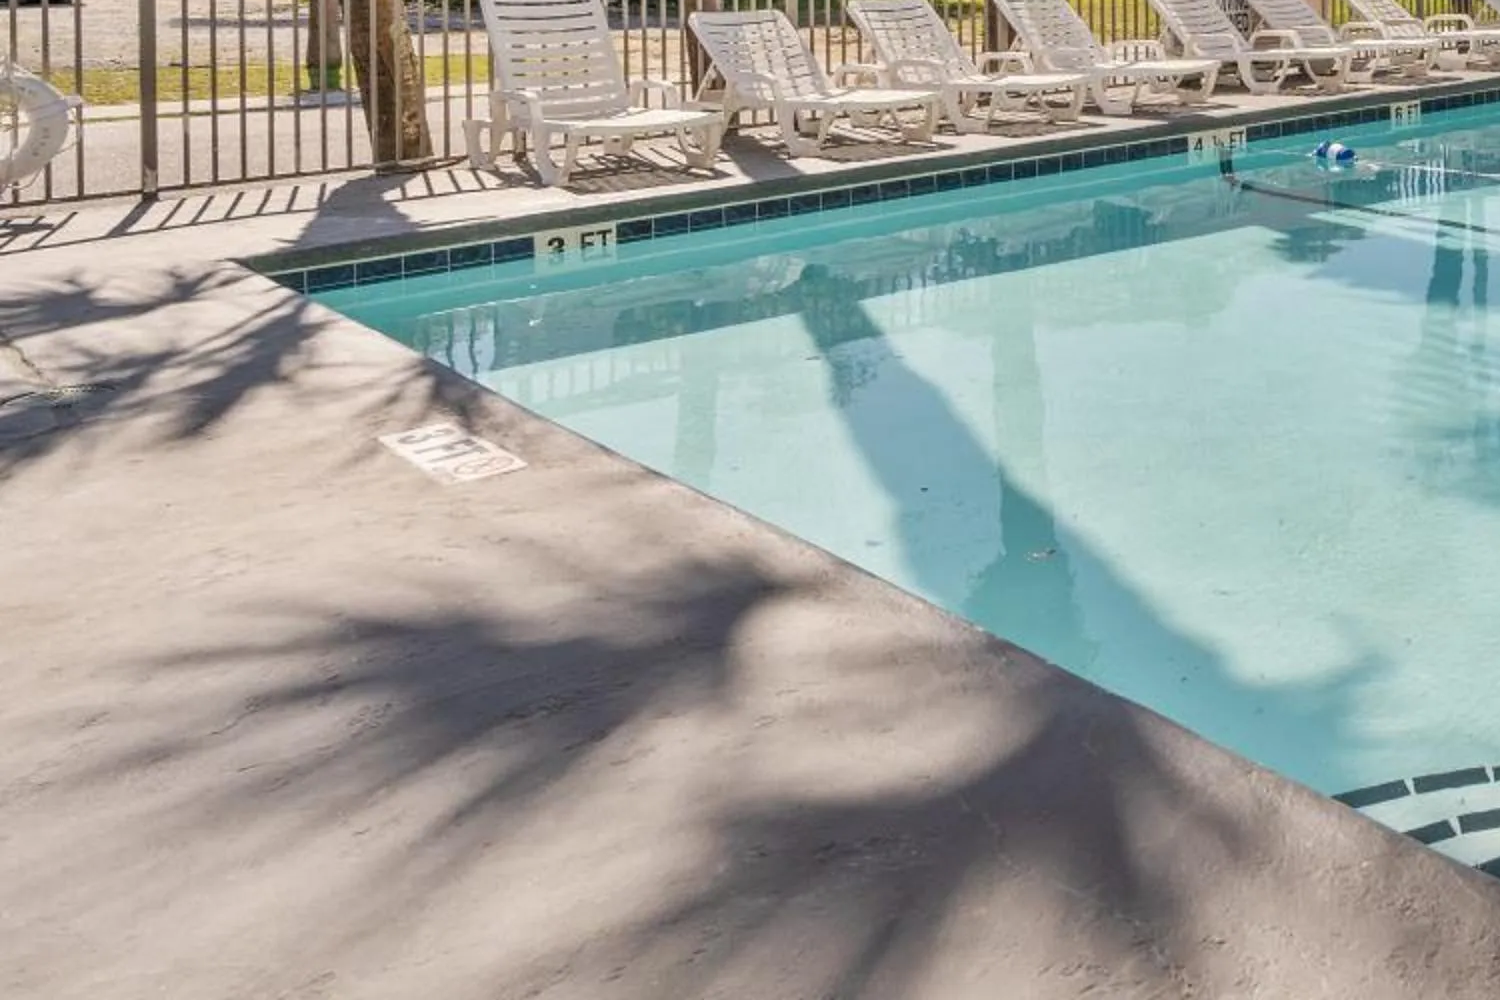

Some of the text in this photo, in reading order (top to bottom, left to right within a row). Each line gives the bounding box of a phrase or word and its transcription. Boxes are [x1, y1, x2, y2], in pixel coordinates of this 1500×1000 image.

[1230, 131, 1244, 147] FT
[581, 228, 612, 248] FT
[397, 428, 490, 463] 3 FT
